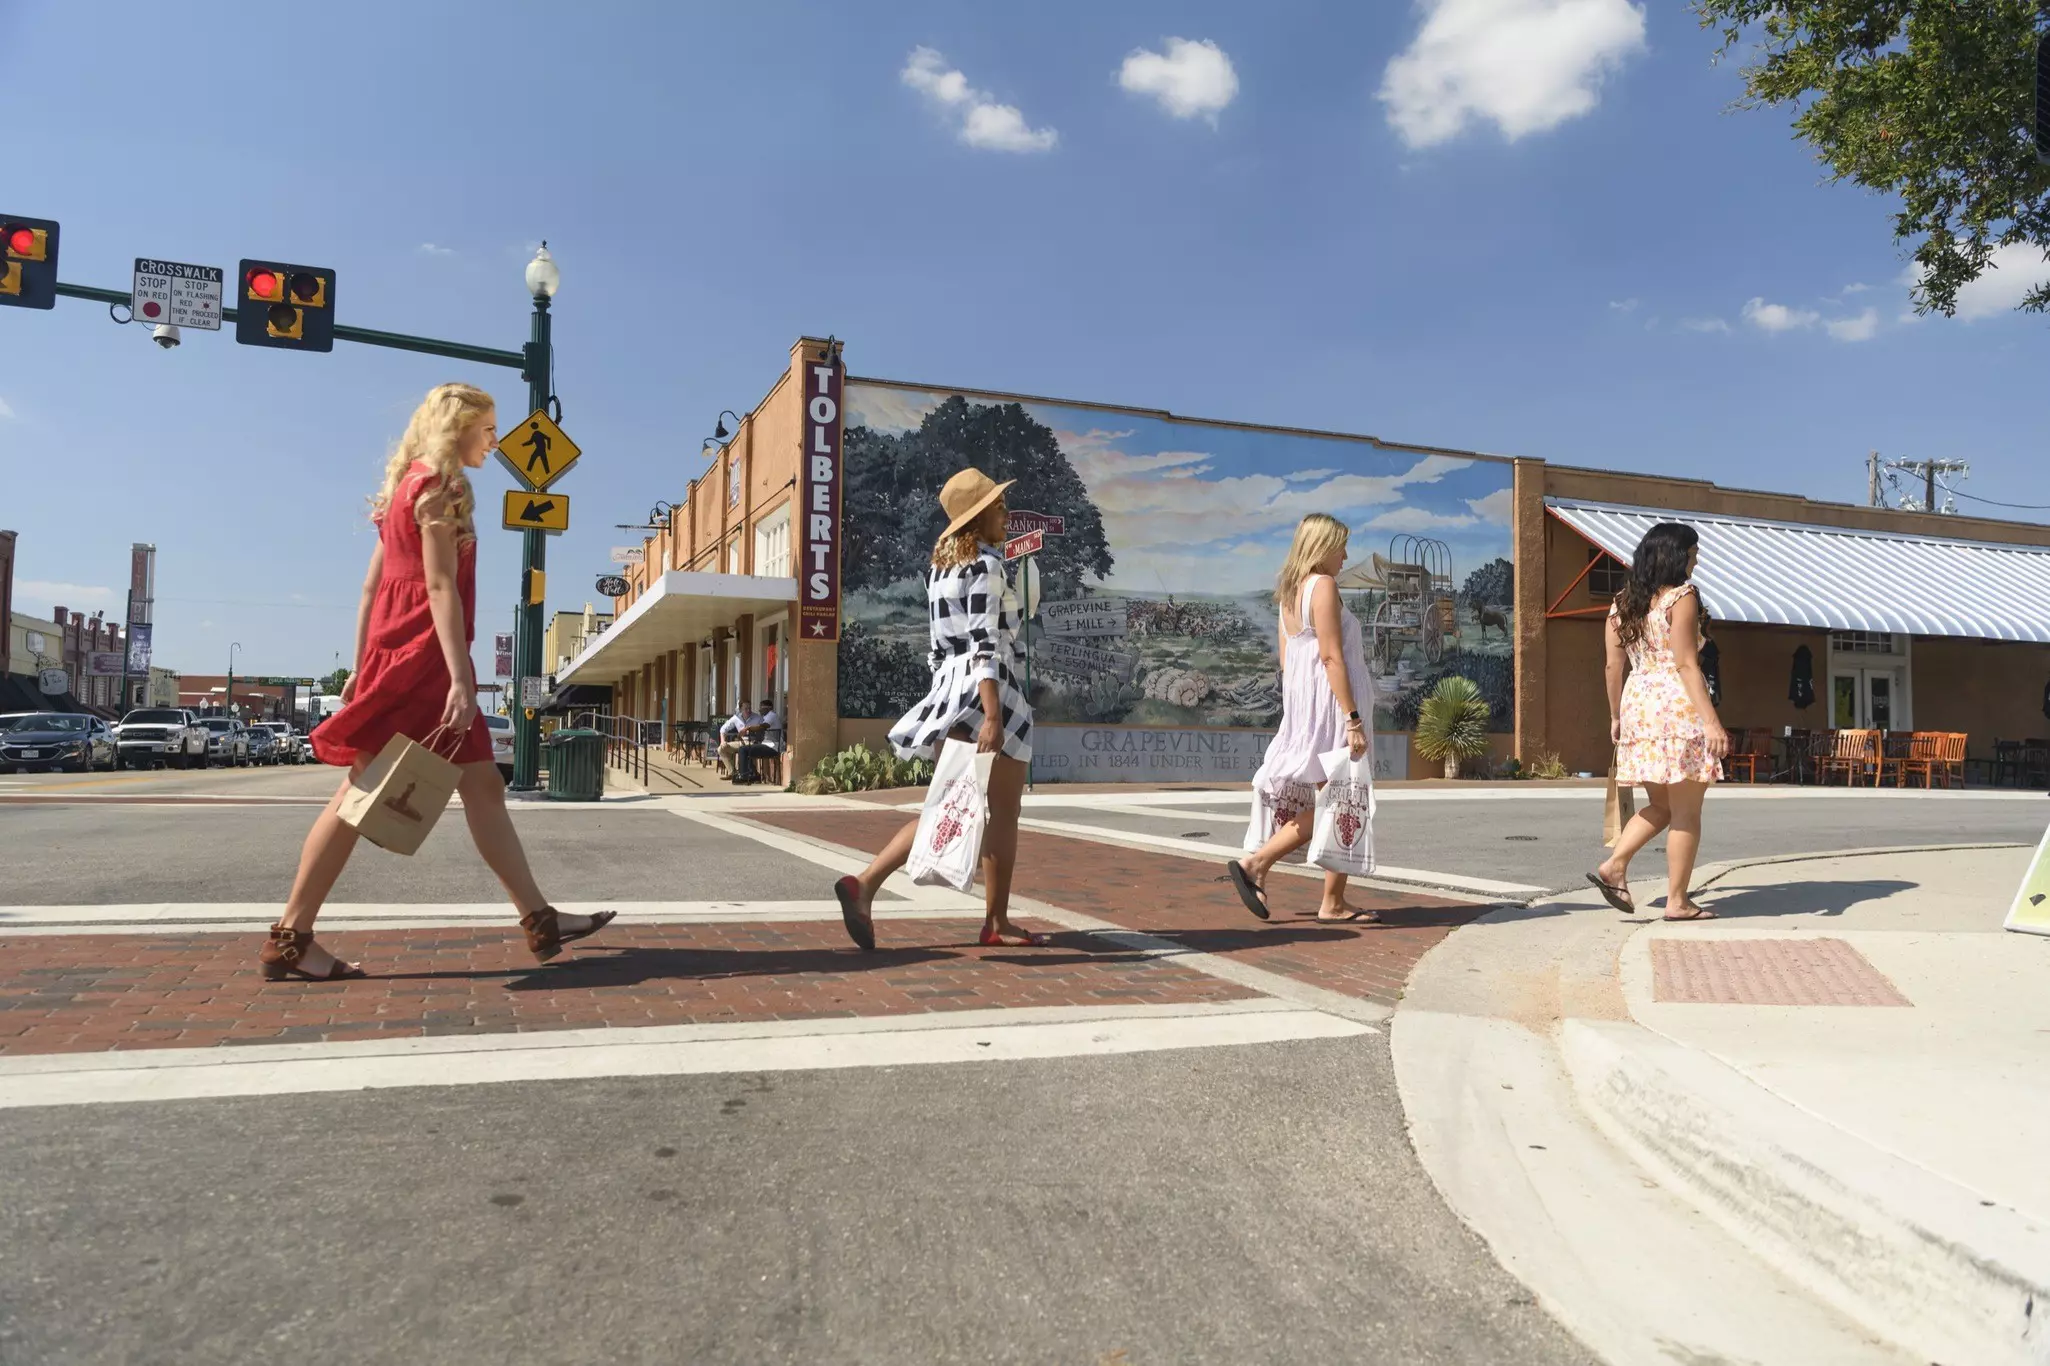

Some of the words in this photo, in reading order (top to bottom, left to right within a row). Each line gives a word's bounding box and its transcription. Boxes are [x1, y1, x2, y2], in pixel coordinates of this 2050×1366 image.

[140, 261, 217, 281] CROSSWALK
[140, 277, 167, 288] STOP
[184, 281, 208, 291] STOP
[138, 290, 149, 298] ON
[152, 291, 168, 300] RED
[187, 291, 219, 301] FLASHING
[192, 309, 219, 319] PROCEED
[190, 318, 211, 326] CLEAR
[808, 367, 837, 600] TOLBERTS
[1007, 520, 1048, 532] RANKLIN
[1015, 539, 1030, 556] MAIN
[1048, 601, 1112, 617] GRAPEVINE
[1064, 619, 1072, 631] 1
[1076, 618, 1104, 630] MILE
[1049, 642, 1116, 664] TERLINGUA
[1065, 657, 1086, 669] 550
[1032, 755, 1070, 768] TLED
[1079, 755, 1098, 768] IN
[1107, 755, 1139, 768] 1844
[1149, 755, 1203, 768] UNDER
[1211, 757, 1240, 769] THE
